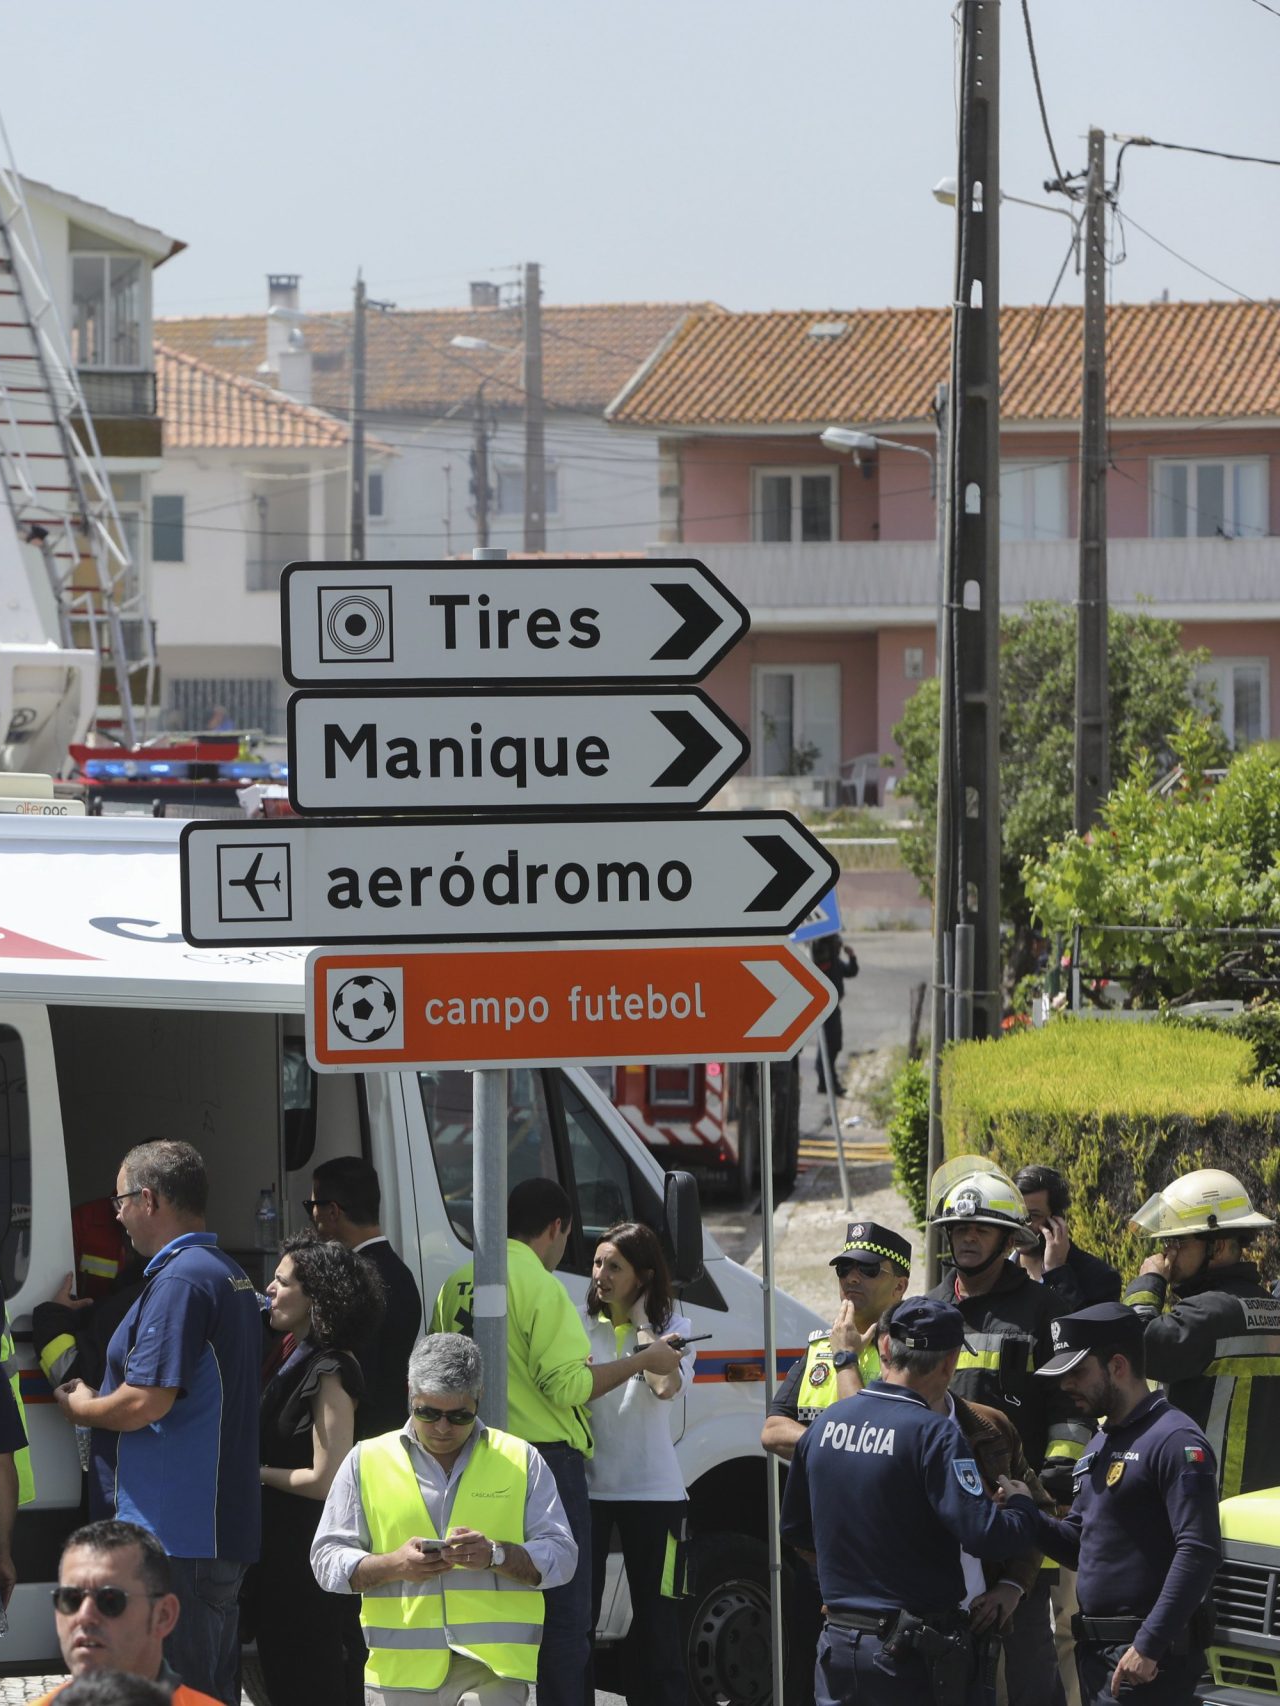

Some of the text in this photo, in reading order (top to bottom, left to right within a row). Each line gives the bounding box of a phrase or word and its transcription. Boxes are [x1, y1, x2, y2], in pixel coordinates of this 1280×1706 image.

[429, 593, 601, 649] Tires
[324, 722, 609, 788] Manique
[327, 850, 692, 909] aeródromo
[425, 982, 706, 1031] campo futebol
[820, 1421, 895, 1456] POLÍCIA
